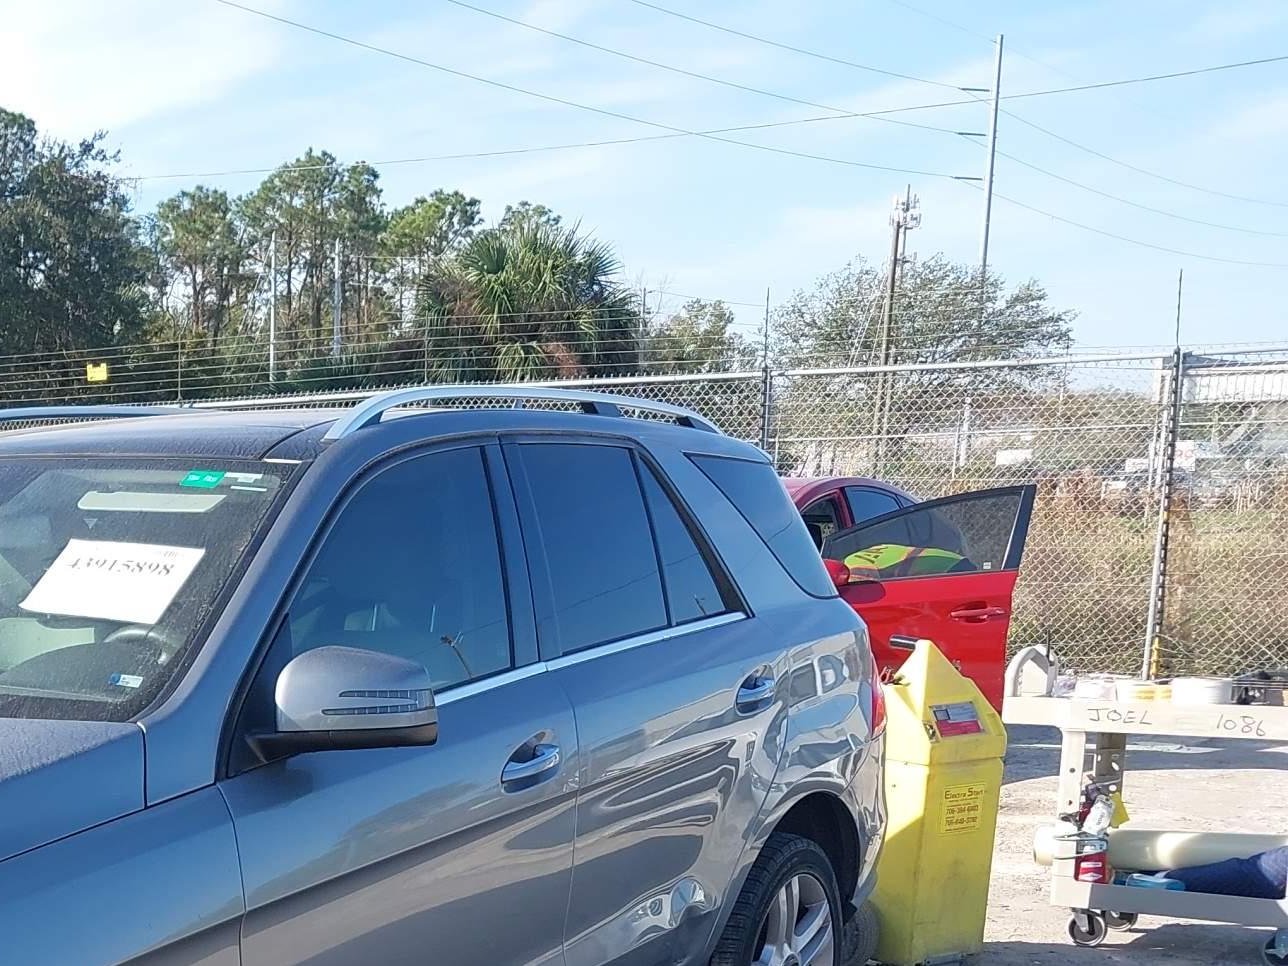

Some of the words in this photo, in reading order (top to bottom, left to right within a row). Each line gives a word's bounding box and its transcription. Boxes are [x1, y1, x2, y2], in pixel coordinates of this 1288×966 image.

[69, 557, 175, 576] 43915898
[1087, 708, 1152, 725] JOEL
[1216, 713, 1266, 737] 1086
